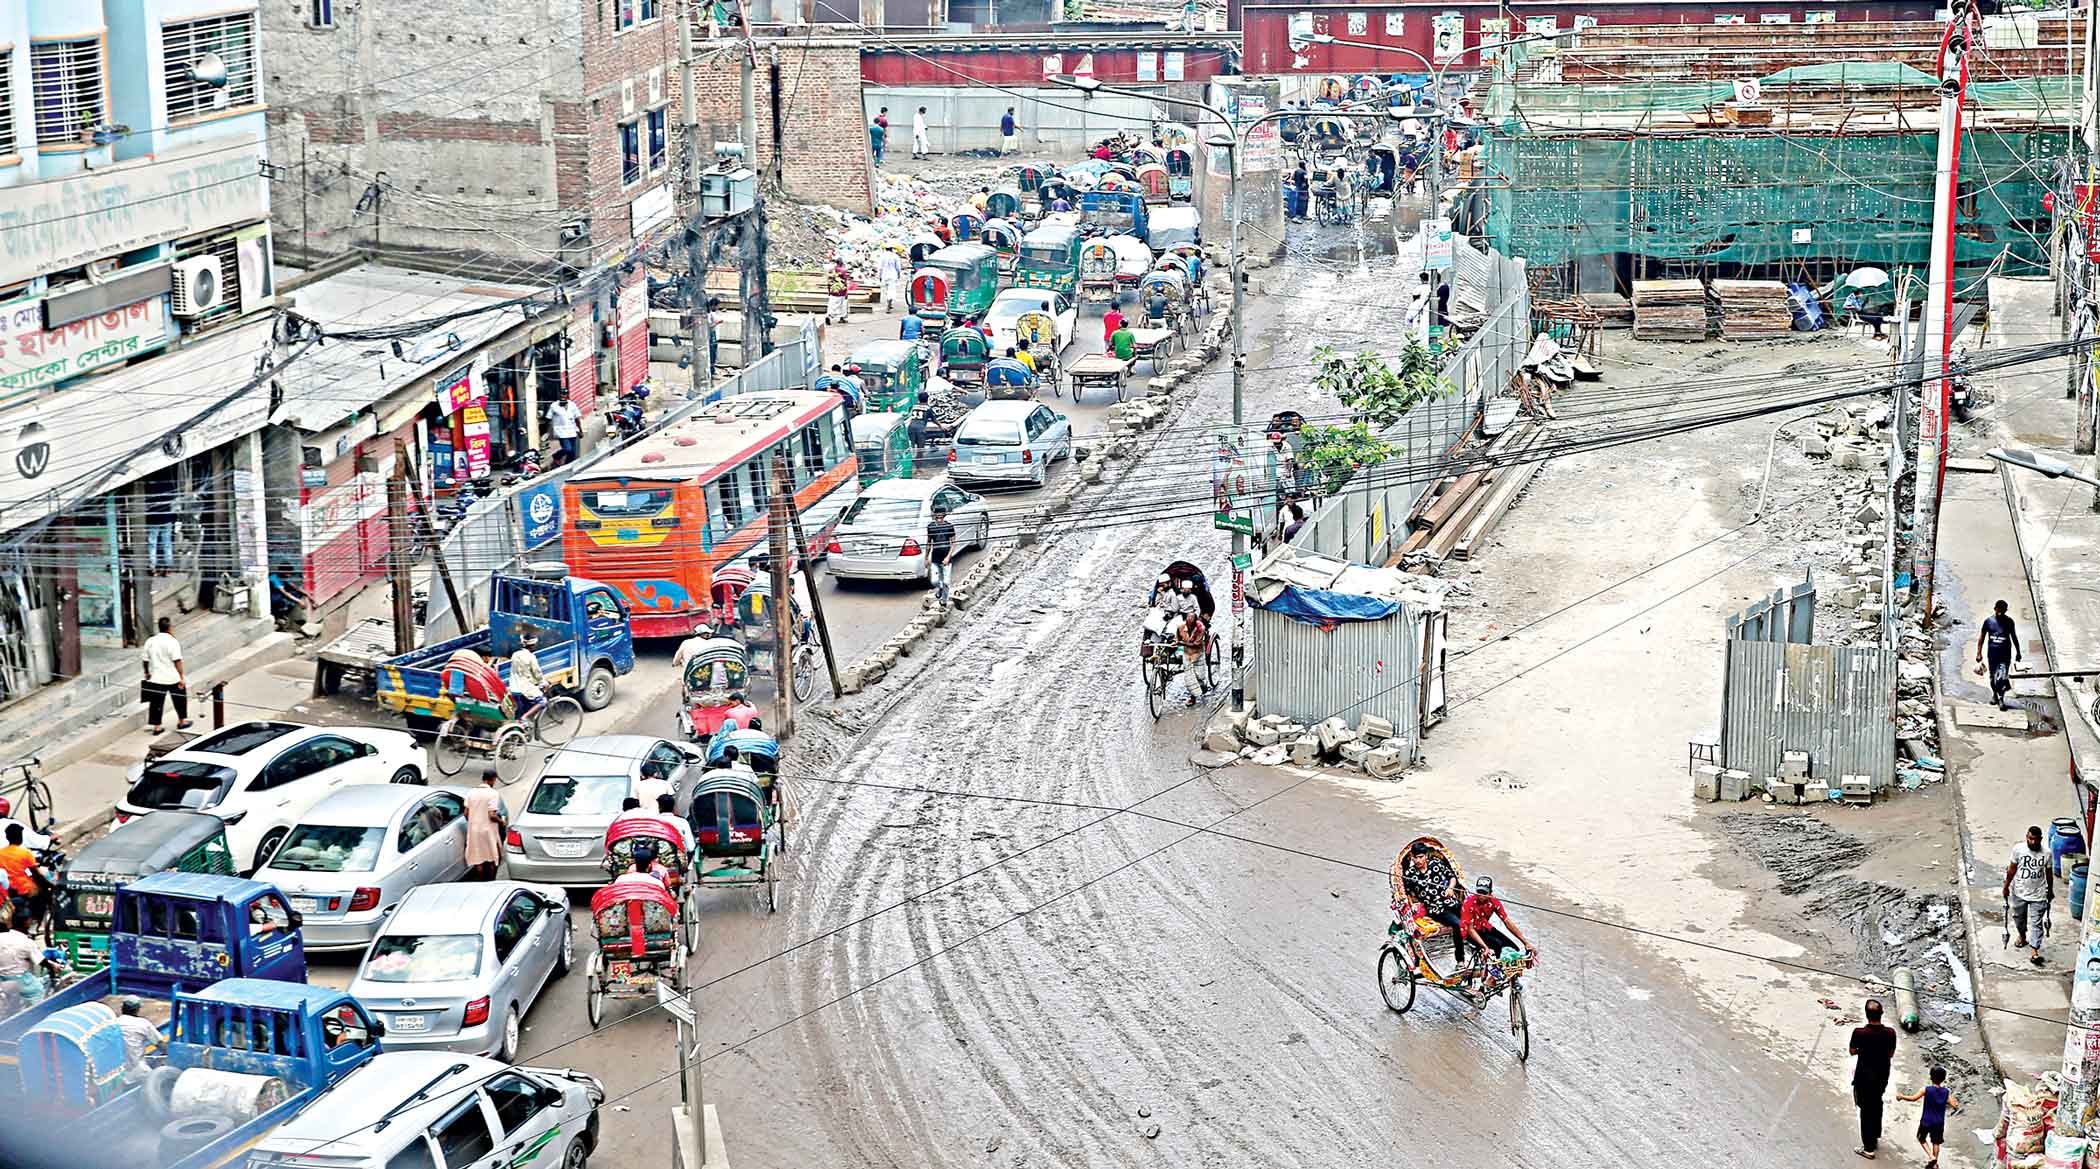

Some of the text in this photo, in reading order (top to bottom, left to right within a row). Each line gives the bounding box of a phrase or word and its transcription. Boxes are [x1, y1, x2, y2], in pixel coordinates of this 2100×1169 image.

[16, 299, 149, 358] হাসপাতাল
[77, 335, 140, 369] সেন্টার
[2020, 868, 2044, 880] Dad
[2021, 855, 2045, 871] Rad
